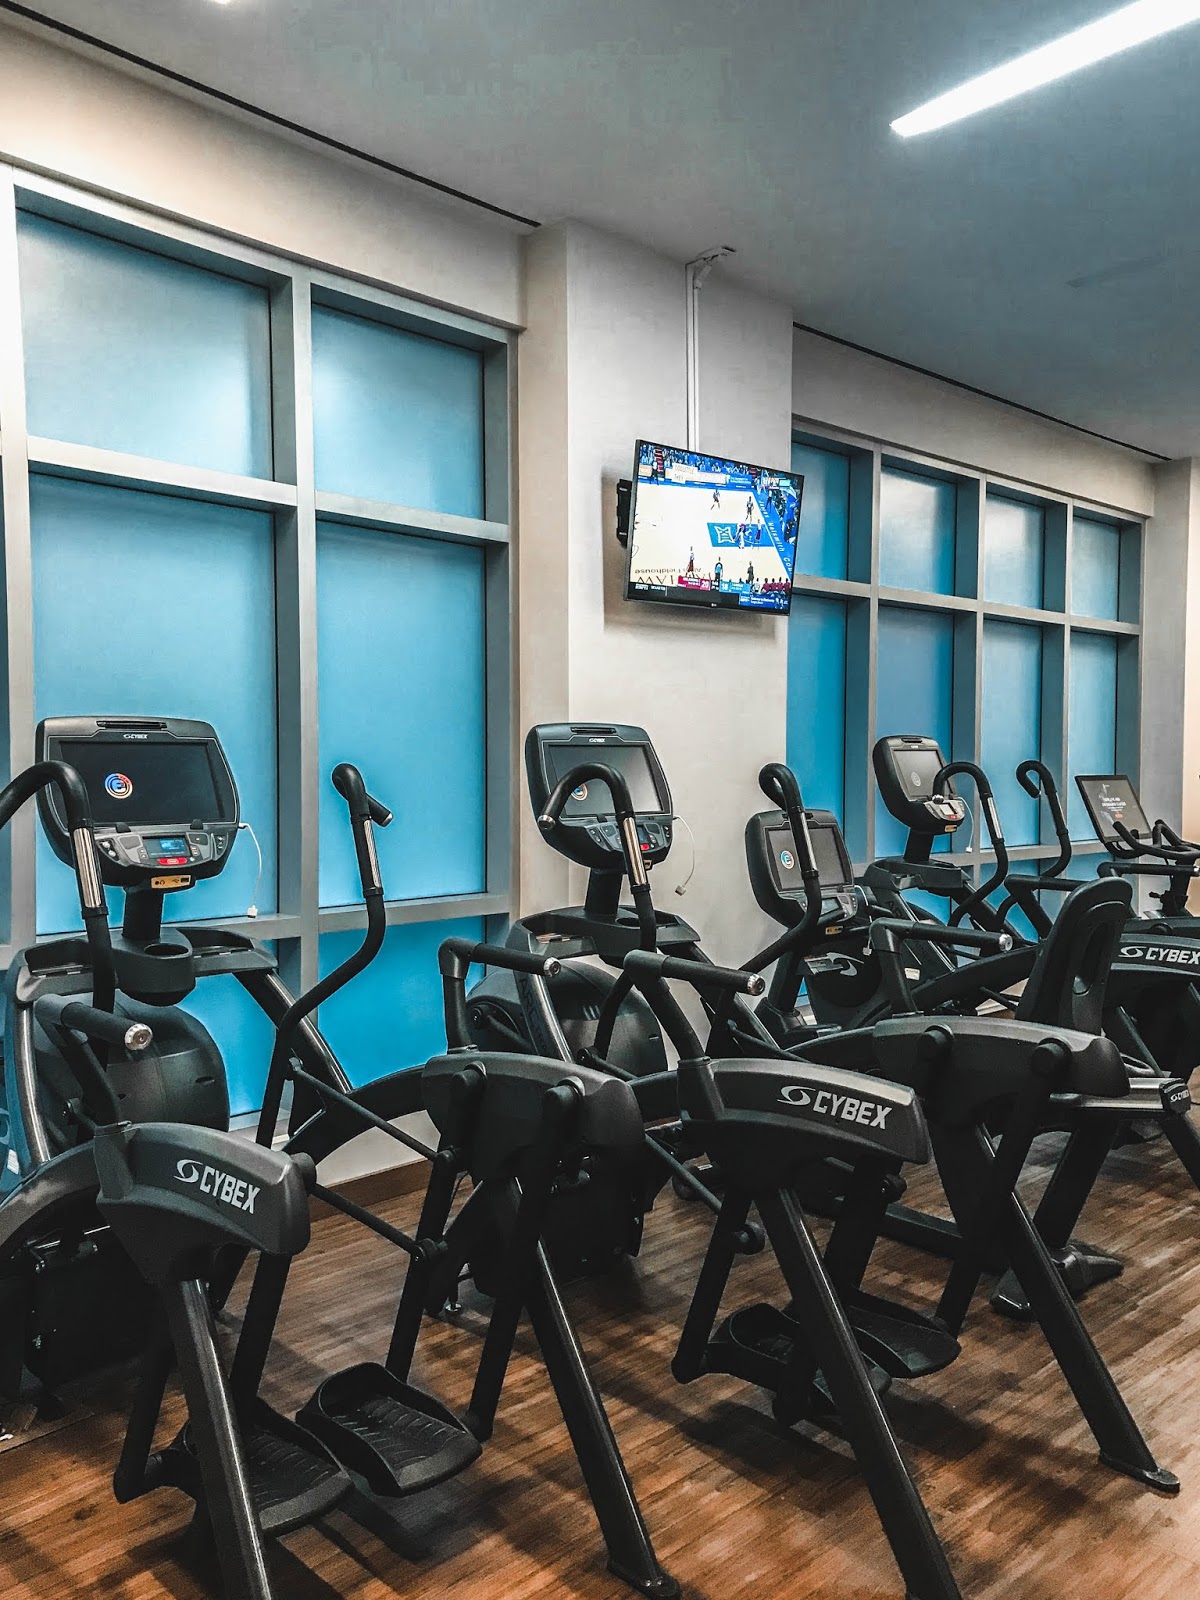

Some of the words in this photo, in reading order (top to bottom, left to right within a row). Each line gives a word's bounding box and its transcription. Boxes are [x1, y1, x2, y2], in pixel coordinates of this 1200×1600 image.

[1145, 947, 1200, 965] CYBEX
[813, 1090, 892, 1130] CYBEX
[200, 1165, 261, 1215] CYBEX
